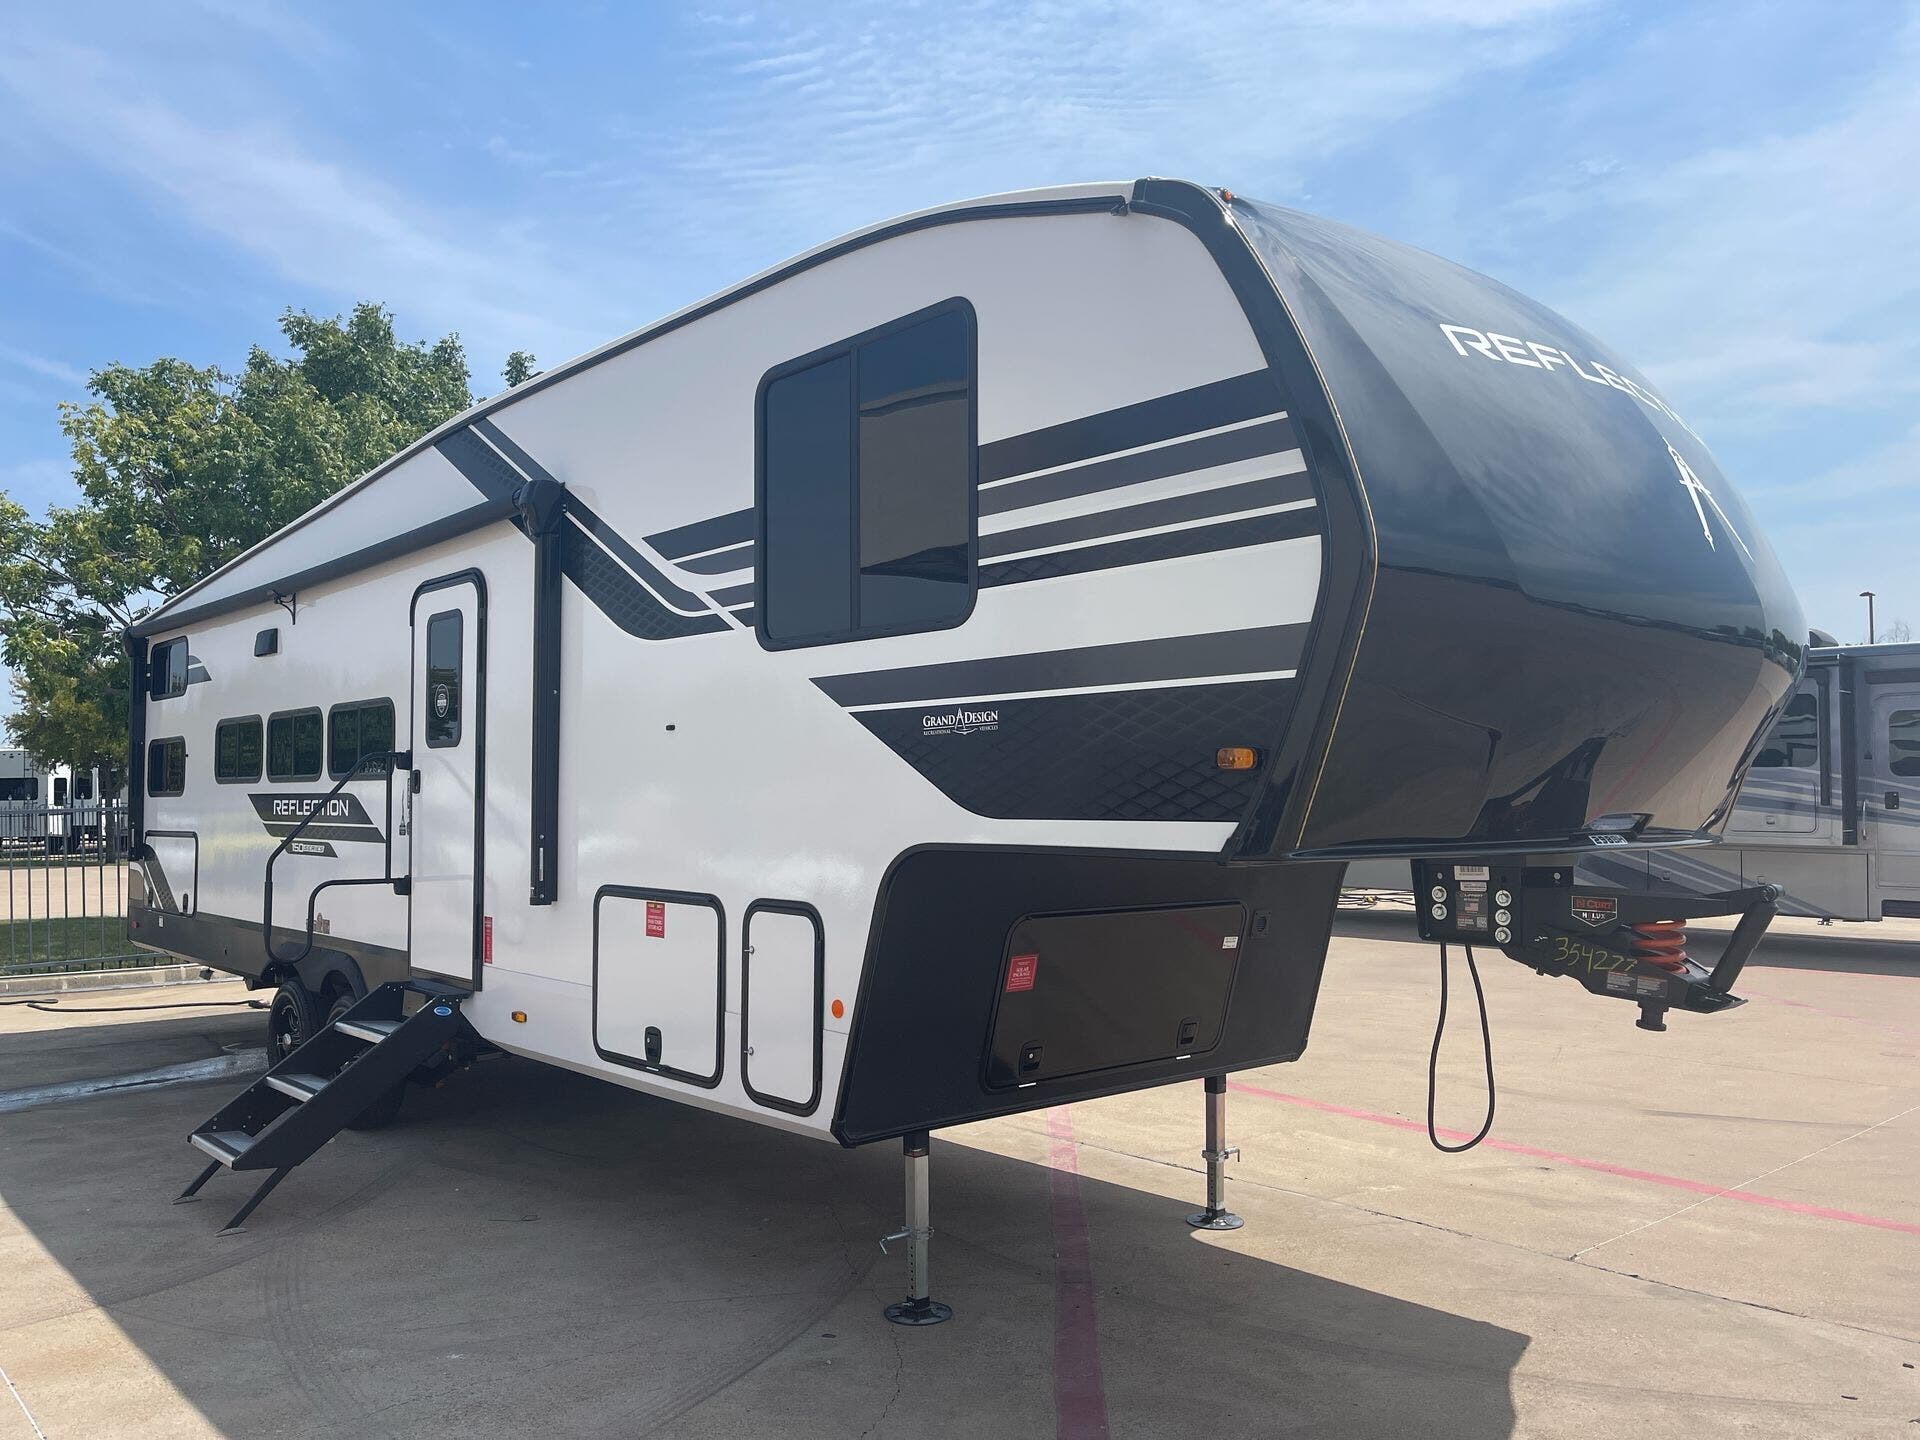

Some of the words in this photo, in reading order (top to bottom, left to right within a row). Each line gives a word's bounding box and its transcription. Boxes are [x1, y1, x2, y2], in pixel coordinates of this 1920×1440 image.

[1439, 323, 1710, 453] REFLECT
[922, 715, 956, 727] GRAND
[964, 710, 999, 724] DESIGN
[1553, 937, 1638, 975] 354277
